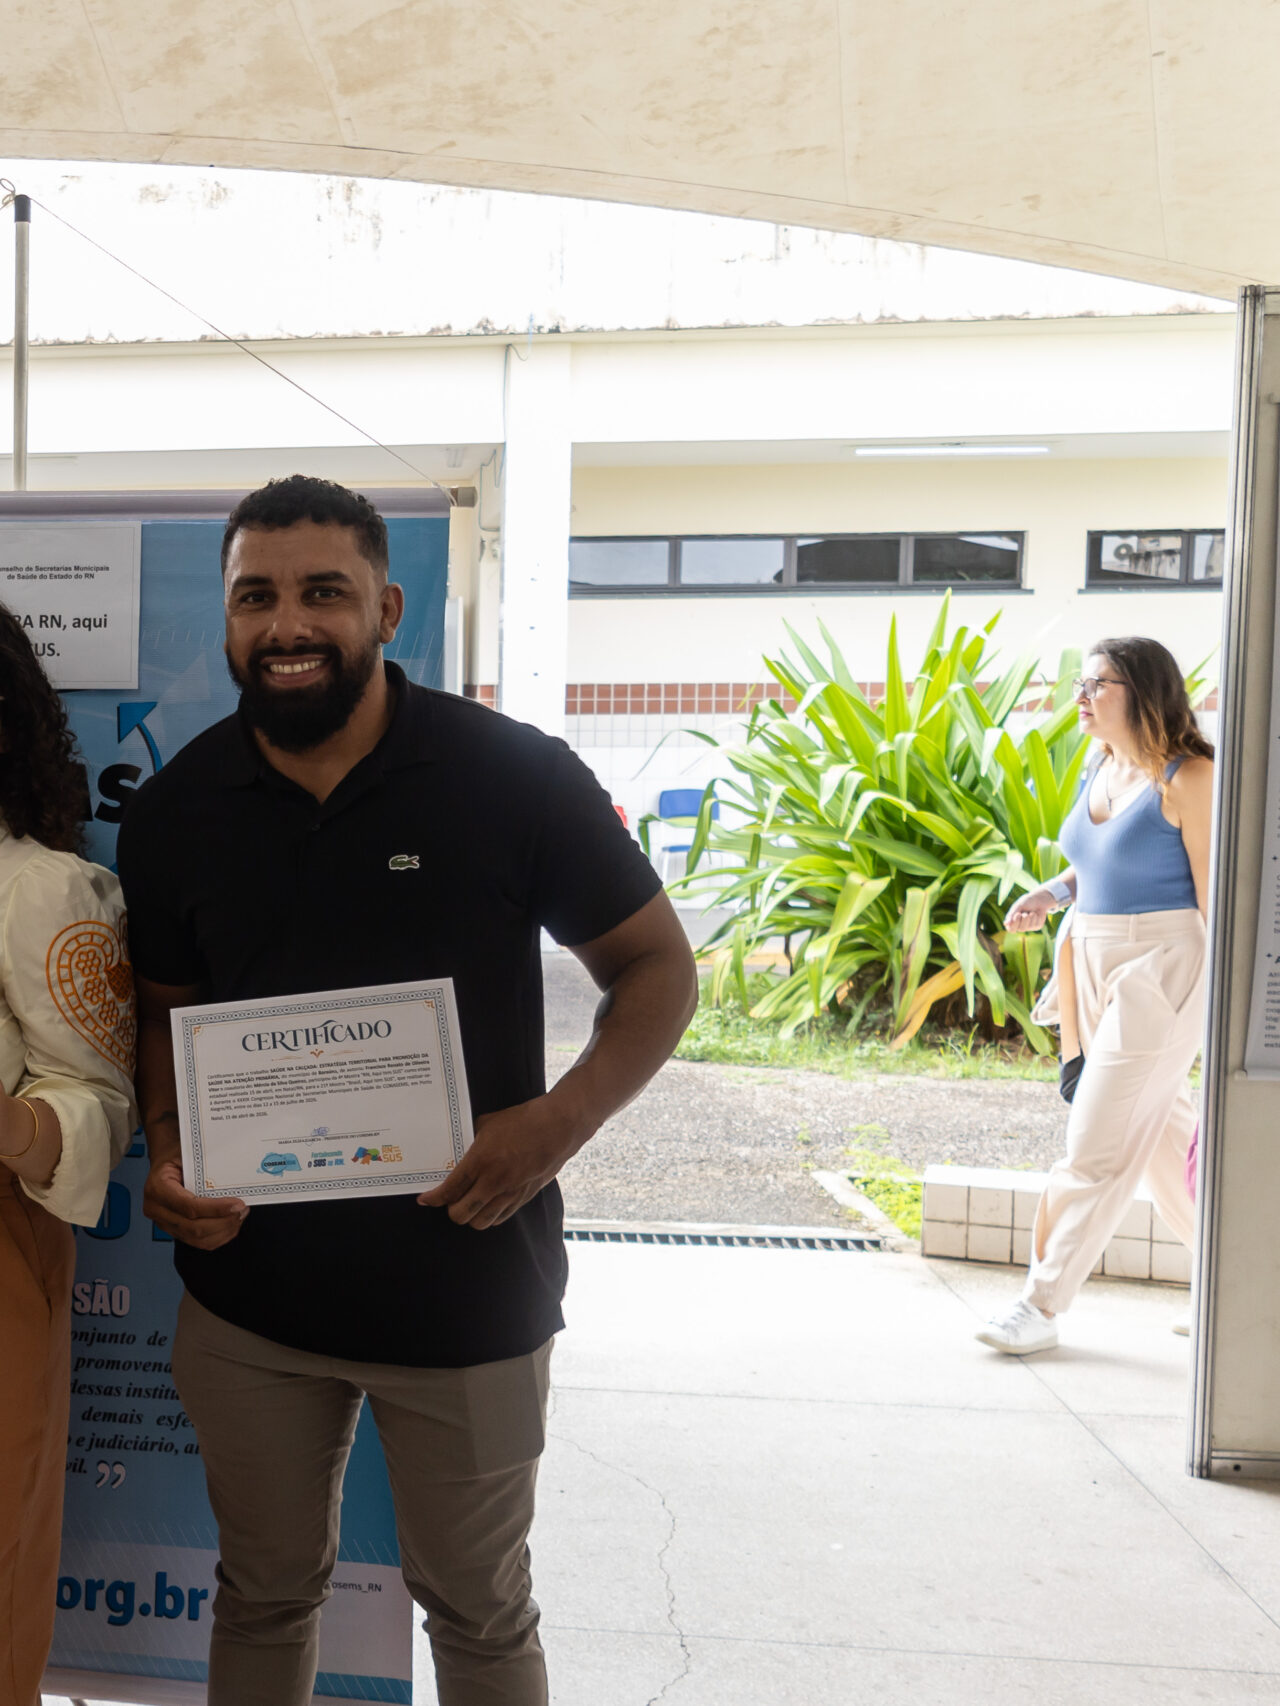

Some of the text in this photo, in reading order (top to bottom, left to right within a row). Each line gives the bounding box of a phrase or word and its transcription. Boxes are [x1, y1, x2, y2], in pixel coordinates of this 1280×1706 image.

[39, 614, 67, 631] RN,
[72, 614, 108, 632] aqui
[31, 642, 60, 656] US.
[242, 1020, 392, 1052] CERTIFICADO
[382, 1152, 403, 1162] SUS
[72, 1278, 130, 1317] SÃO
[71, 1328, 168, 1346] onjunto de
[81, 1406, 194, 1430] demais esfe
[76, 1436, 86, 1448] e
[85, 1432, 178, 1456] judiciário,
[330, 1580, 382, 1593] osems_RN
